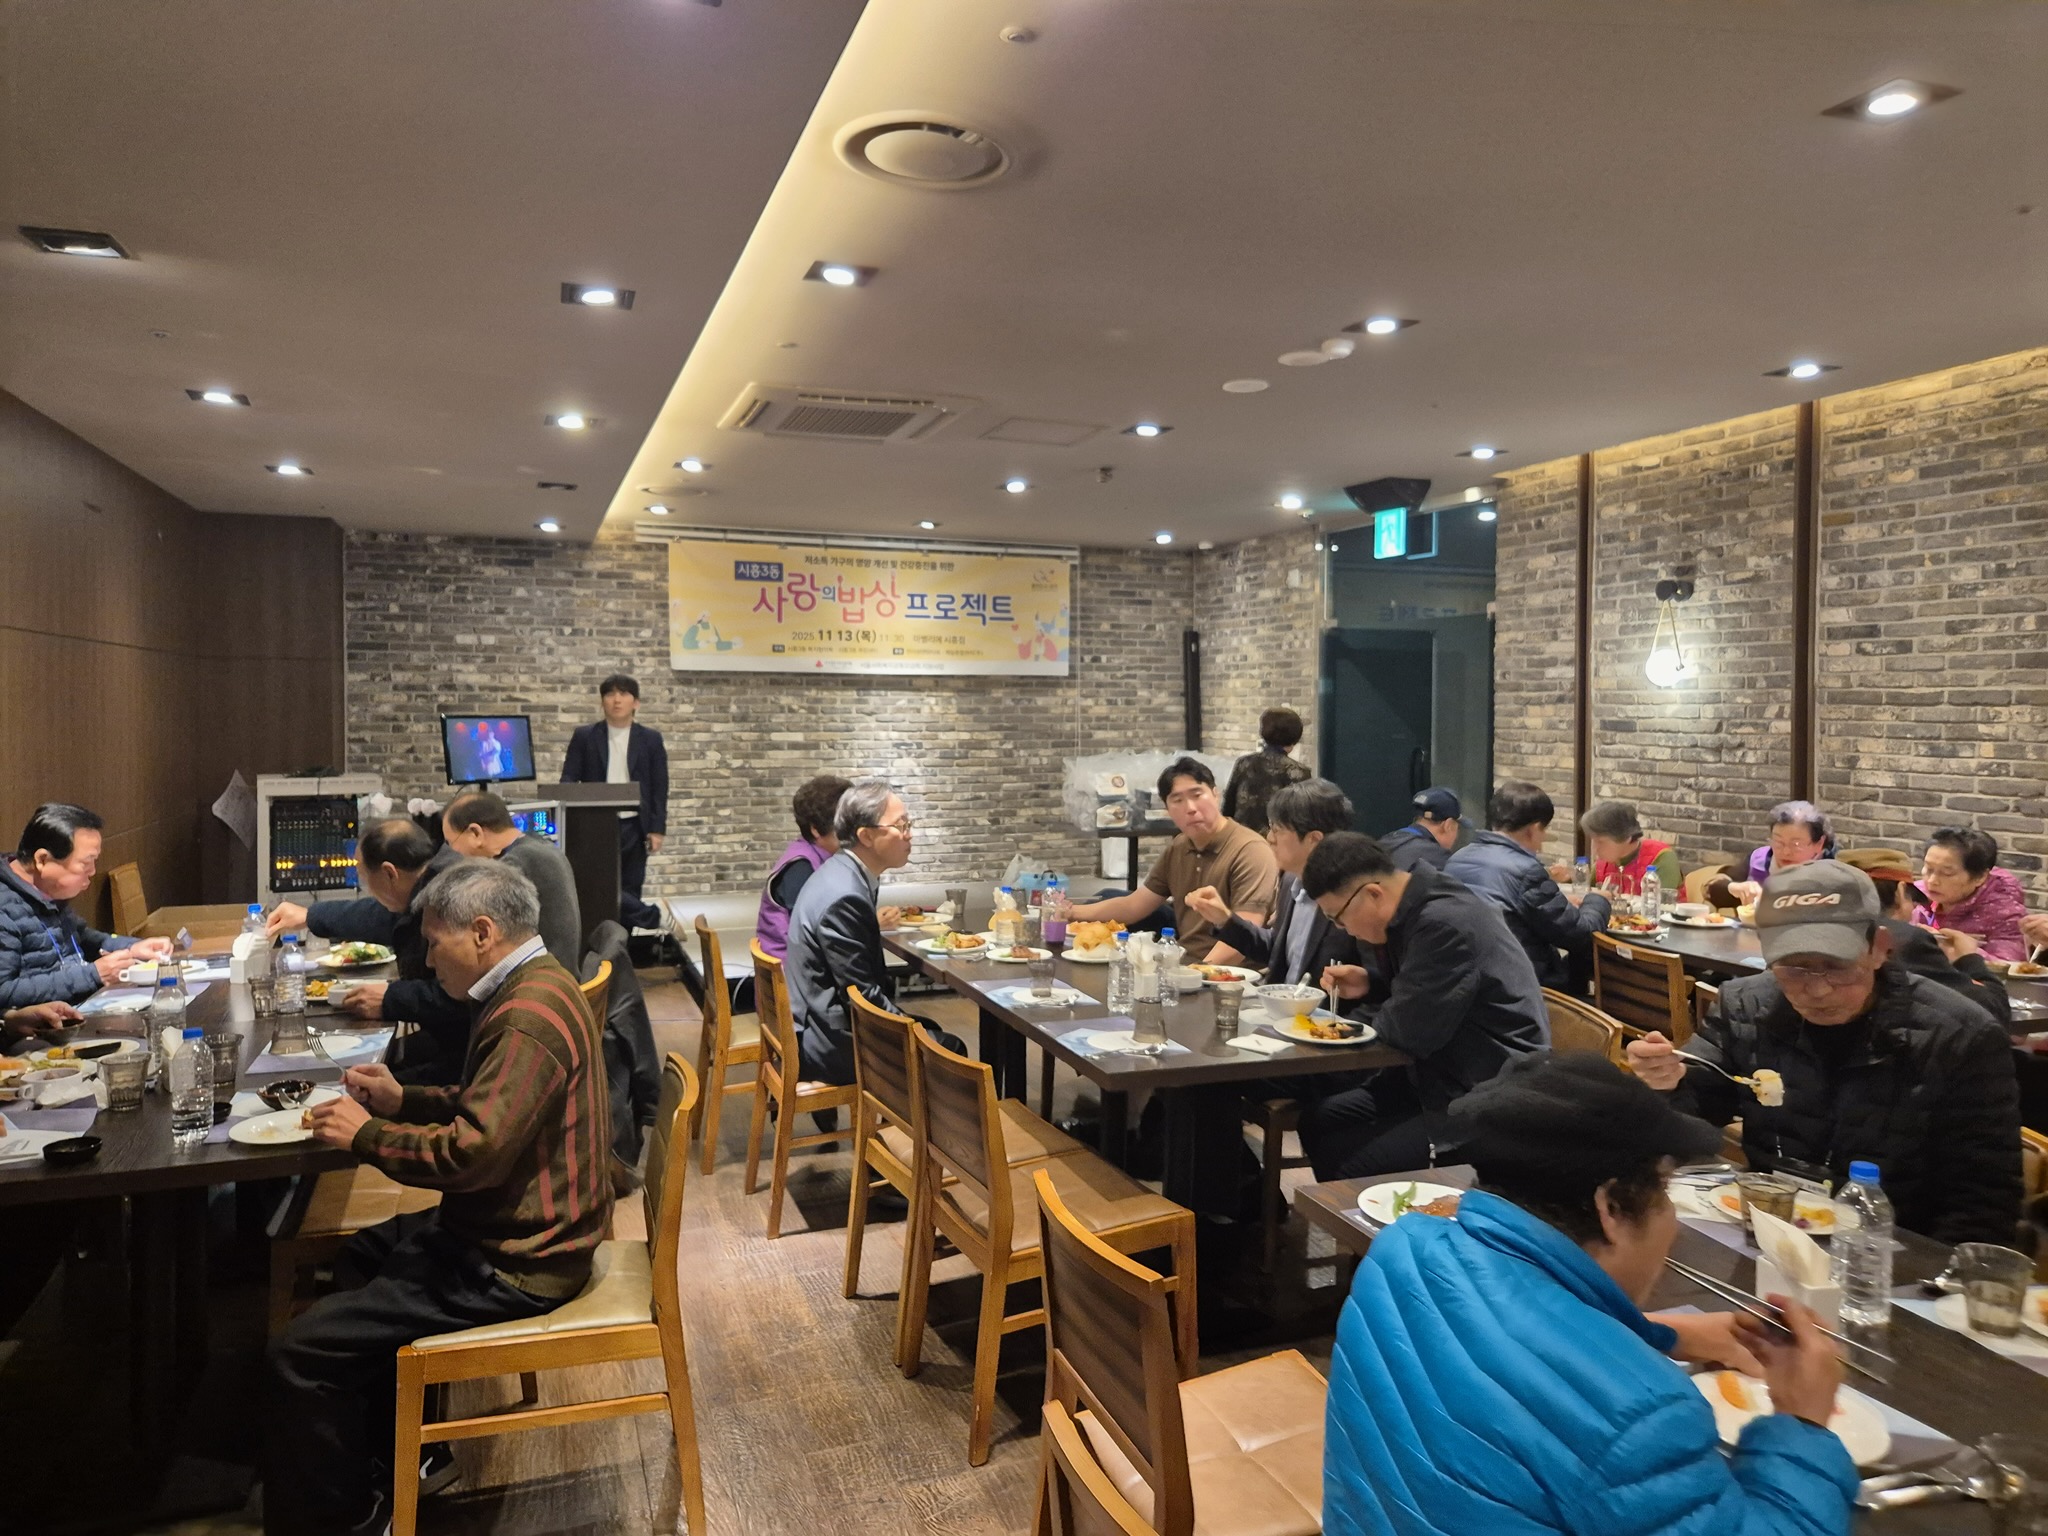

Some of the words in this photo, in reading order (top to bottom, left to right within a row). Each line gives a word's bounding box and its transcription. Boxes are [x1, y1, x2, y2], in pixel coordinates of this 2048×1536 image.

[830, 557, 854, 567] 가구의
[737, 563, 781, 580] 시흥3동
[904, 592, 1015, 627] 프로젝트
[1772, 893, 1842, 909] GIGA
